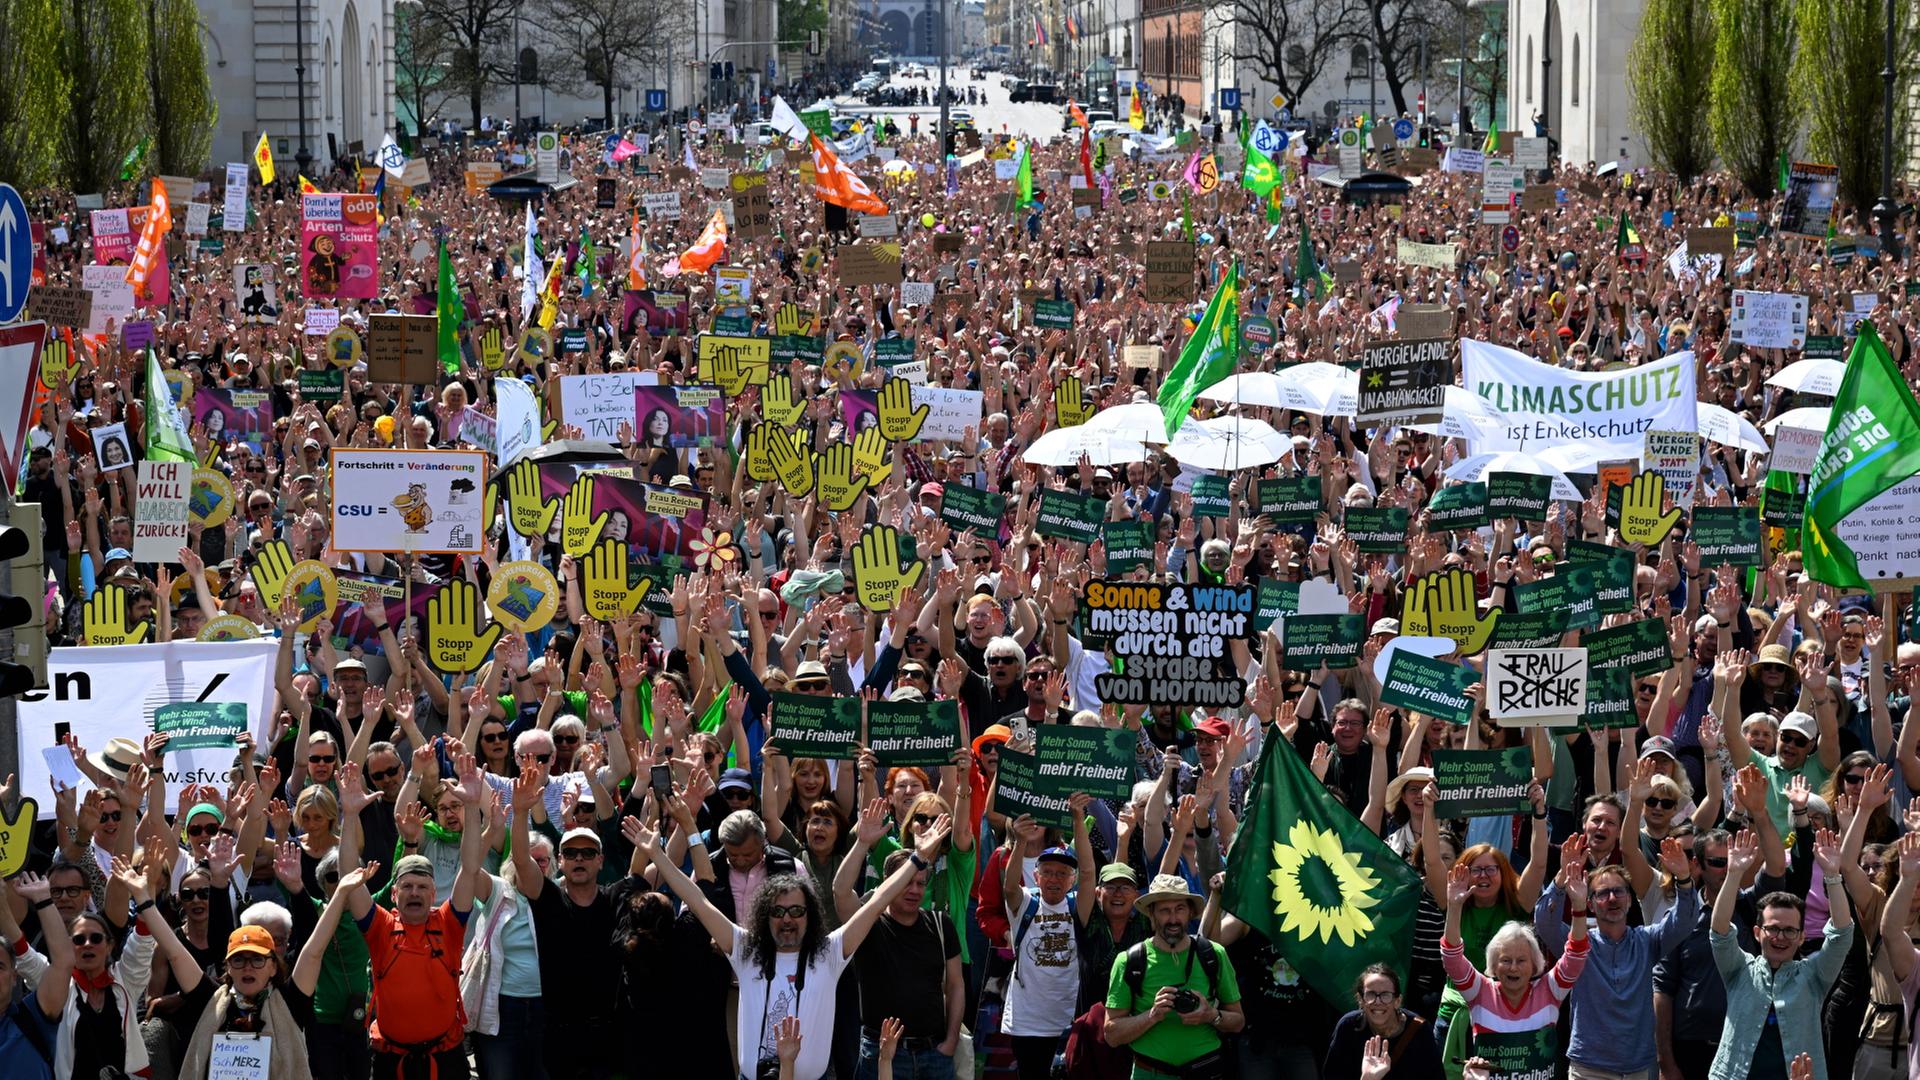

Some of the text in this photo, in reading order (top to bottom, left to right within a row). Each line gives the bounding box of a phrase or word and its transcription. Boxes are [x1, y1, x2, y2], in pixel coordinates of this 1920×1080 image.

[650, 93, 661, 108] U
[1225, 92, 1236, 106] U
[347, 200, 376, 213] ödp
[306, 221, 343, 232] Arten
[97, 237, 131, 248] Klima
[341, 233, 374, 243] Schutz
[1363, 341, 1450, 369] ENERGIEWENDE
[897, 365, 921, 375] OMAS
[1478, 364, 1682, 415] KLIMASCHUTZ
[944, 393, 953, 403] to
[959, 394, 973, 403] the
[886, 416, 911, 426] Stopp
[888, 425, 907, 434] Gas!
[948, 426, 965, 435] Reic
[1508, 418, 1655, 440] ist Enkelschutz
[1651, 446, 1692, 455] WENDE
[338, 461, 394, 470] Fortschritt
[407, 462, 475, 472] Veränderung
[1660, 459, 1687, 467] STATT
[151, 464, 177, 481] ICH
[140, 483, 182, 499] WILL
[823, 484, 848, 497] Stopp
[650, 493, 669, 502] Frau
[1508, 497, 1544, 510] Freiheit!
[338, 505, 372, 517] CSU
[517, 506, 542, 518] Stopp
[657, 506, 684, 516] reicht!
[1261, 500, 1318, 513] mehr Freiheit!
[1450, 506, 1484, 518] Freiheit!
[1865, 503, 1904, 512] oder weiter
[519, 518, 538, 529] Gas!
[943, 507, 997, 528] mehr Freiheit!
[1041, 512, 1098, 532] mehr Freiheit!
[1628, 516, 1658, 528] Stopp
[1842, 519, 1866, 528] Putin,
[1871, 518, 1895, 527] Kohle
[567, 526, 590, 537] Stopp
[1369, 532, 1404, 542] Freiheit!
[1628, 527, 1652, 536] Gas!
[568, 537, 585, 548] Gas!
[1842, 533, 1859, 541] und
[1863, 534, 1890, 543] Kriege
[1720, 543, 1757, 555] Freiheit!
[1855, 551, 1888, 561] Denkt
[337, 579, 369, 591] Schluss
[384, 587, 401, 598] dem
[865, 580, 899, 592] Stopp
[593, 590, 627, 601] Stopp
[869, 591, 894, 603] Gas!
[1086, 583, 1252, 612] Sonne & Wind
[596, 601, 621, 611] Gas!
[1091, 609, 1247, 636] müssen nicht
[1409, 622, 1427, 632] Sto
[1440, 624, 1476, 635] Stopp
[92, 634, 125, 646] Stopp
[437, 638, 474, 650] Stopp
[1115, 631, 1223, 658] durch die
[1287, 643, 1358, 656] mehr Freiheit!
[1621, 645, 1665, 665] Freiheit!
[440, 651, 466, 662] Gas!
[1127, 655, 1212, 680] Straße
[1504, 653, 1565, 677] FRAU
[1099, 679, 1241, 704] von Hormus
[1389, 679, 1470, 710] mehr Freiheit!
[777, 703, 828, 717] Mehr Sonne,
[1588, 700, 1630, 714] Freiheit!
[776, 715, 797, 725] mehr
[872, 712, 923, 724] Mehr Sonne,
[190, 725, 241, 738] Freiheit!
[775, 729, 856, 743] mehr Freiheit!
[872, 726, 893, 735] mehr
[871, 735, 954, 751] mehr Freiheit!
[1041, 736, 1098, 751] Mehr Sonne,
[1040, 750, 1093, 763] mehr Wind,
[1039, 763, 1128, 780] mehr Freiheit!
[1439, 762, 1496, 773] Mehr Sonne,
[1440, 774, 1492, 785] mehr Wind,
[998, 784, 1020, 801] mehr
[1021, 791, 1071, 812] Freiheit!
[1440, 785, 1527, 800] mehr Freiheit!
[215, 1043, 249, 1052] Meine
[1498, 1045, 1531, 1057] Sonne,
